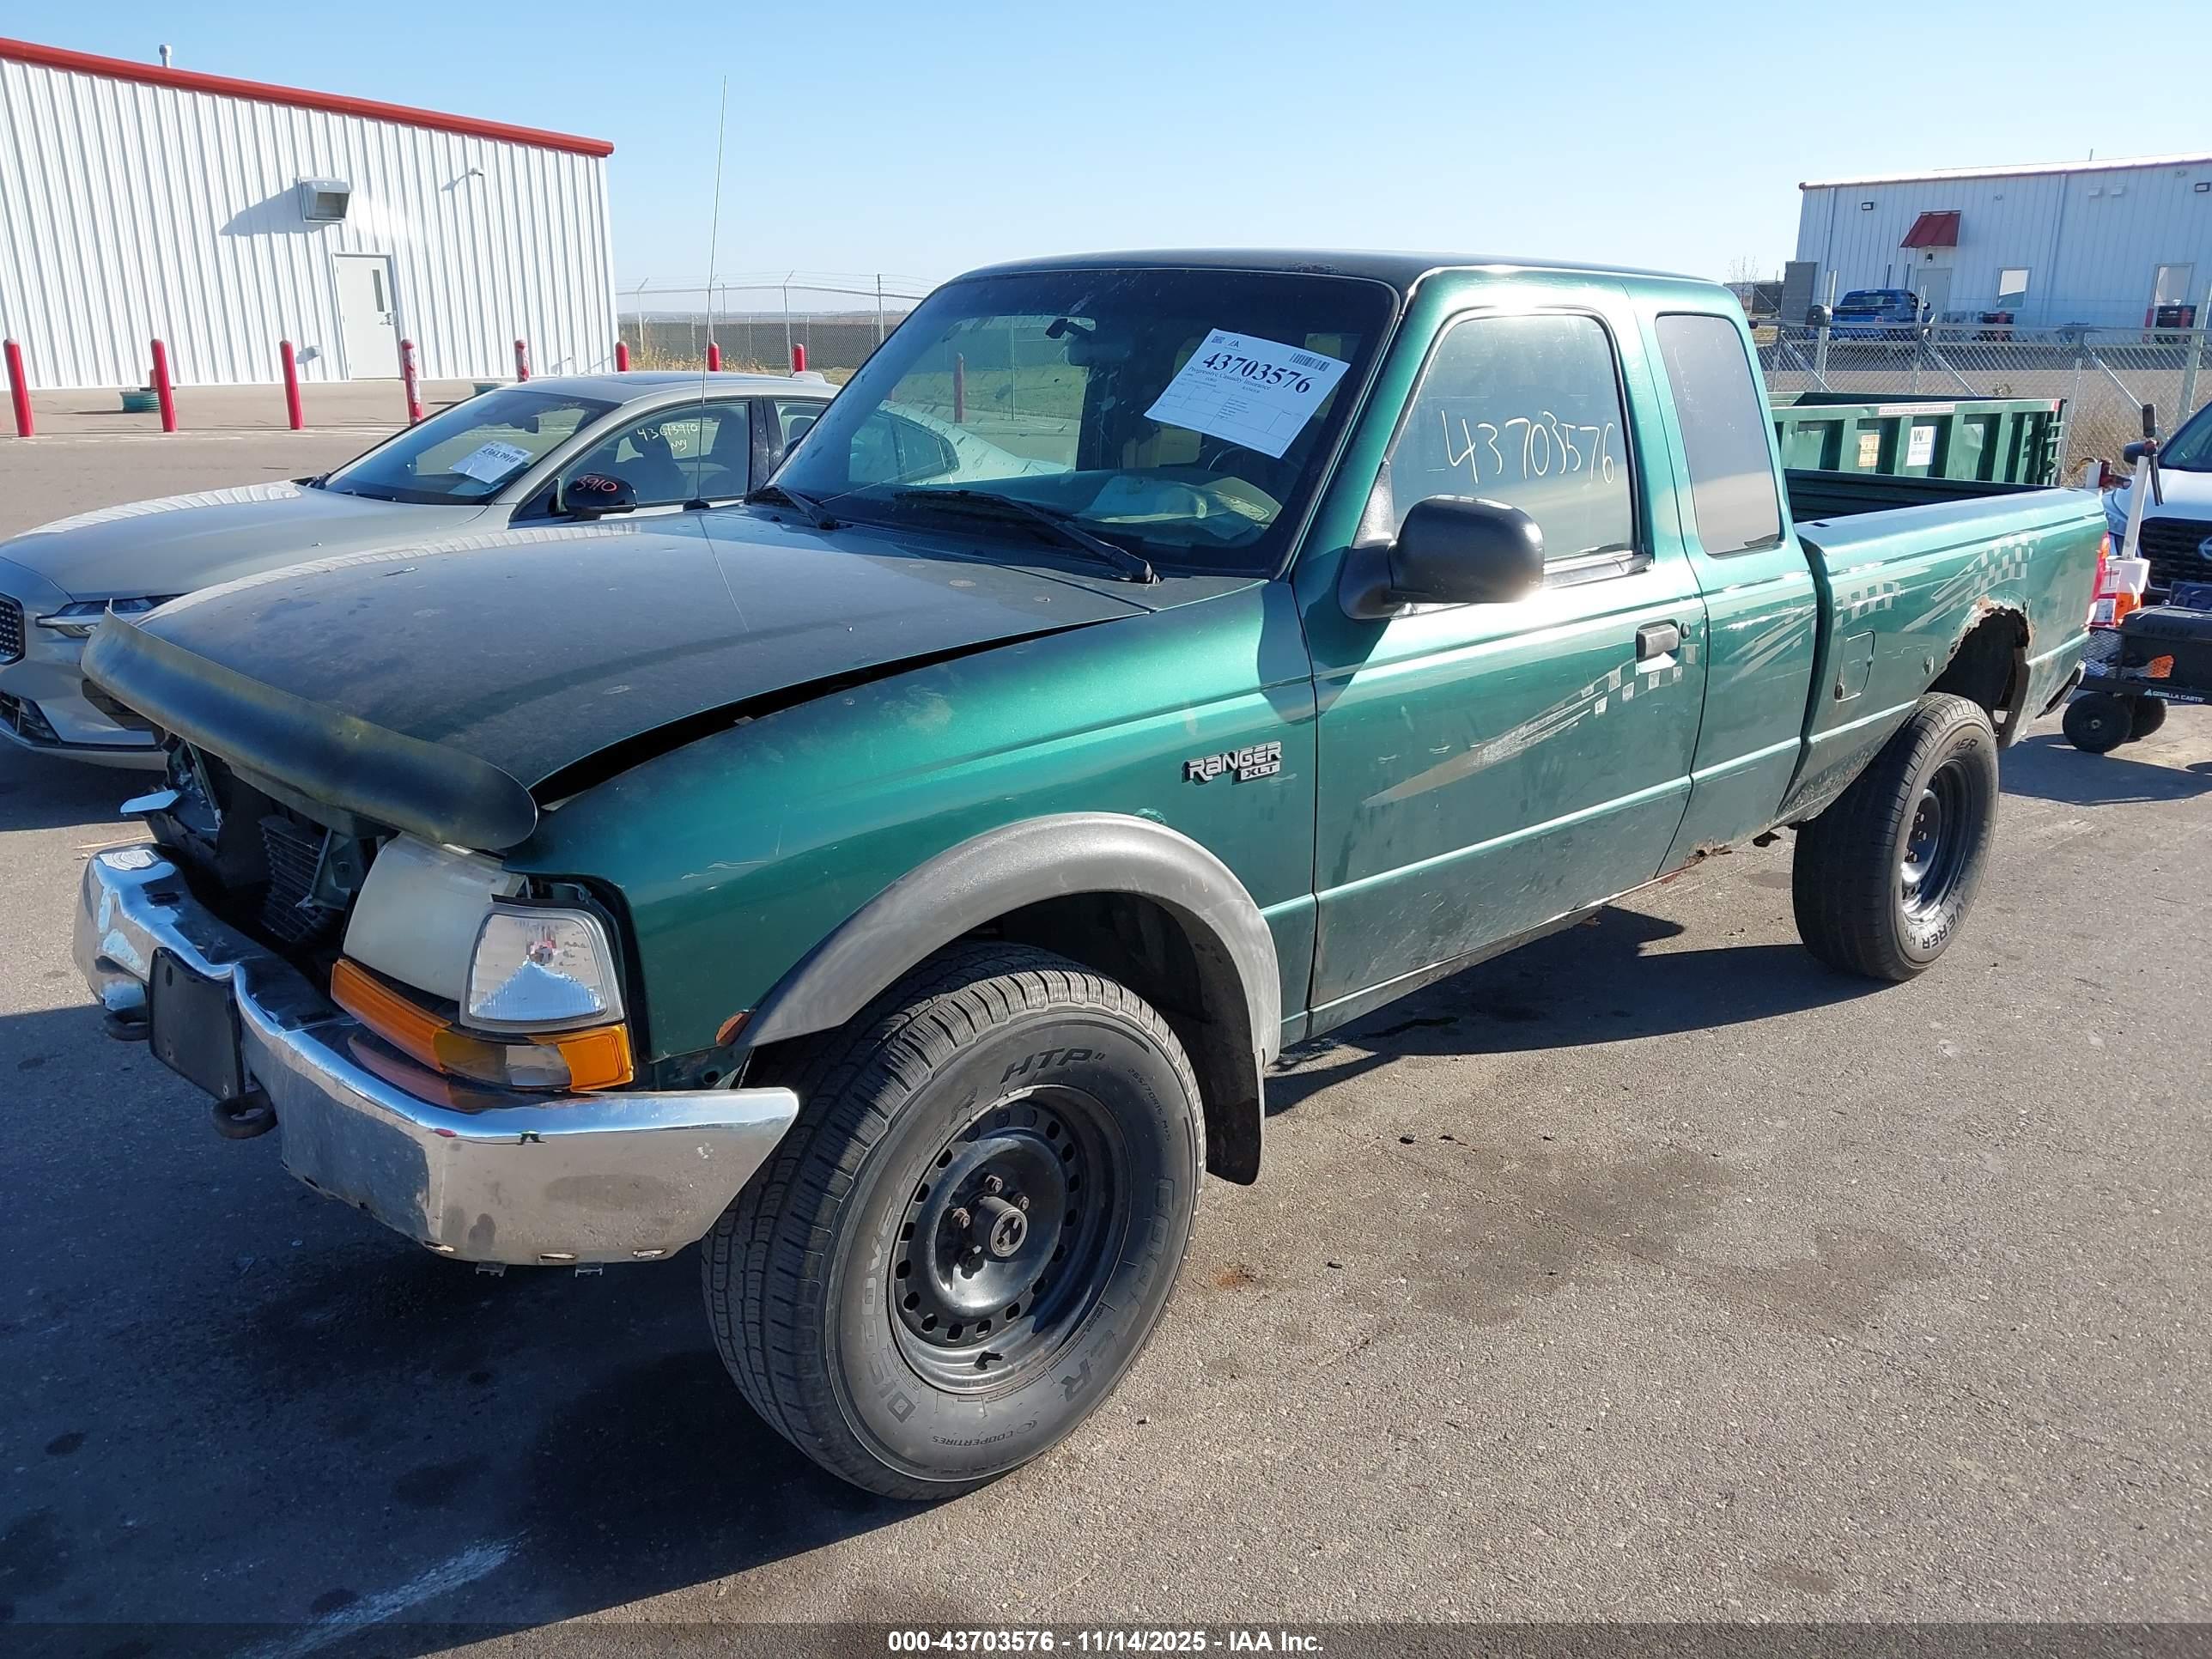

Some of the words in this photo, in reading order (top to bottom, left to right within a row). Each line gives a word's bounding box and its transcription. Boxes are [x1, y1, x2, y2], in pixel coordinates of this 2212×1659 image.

[1188, 366, 1219, 378] Progressive
[1243, 378, 1272, 391] Insurance
[1203, 352, 1318, 393] 43703576
[636, 423, 698, 441] 43613910
[1441, 410, 1615, 484] 43703576
[576, 475, 617, 492] 3910
[1187, 740, 1282, 782] RANGER
[1242, 761, 1280, 780] XLT
[1000, 1048, 1093, 1085] HTP
